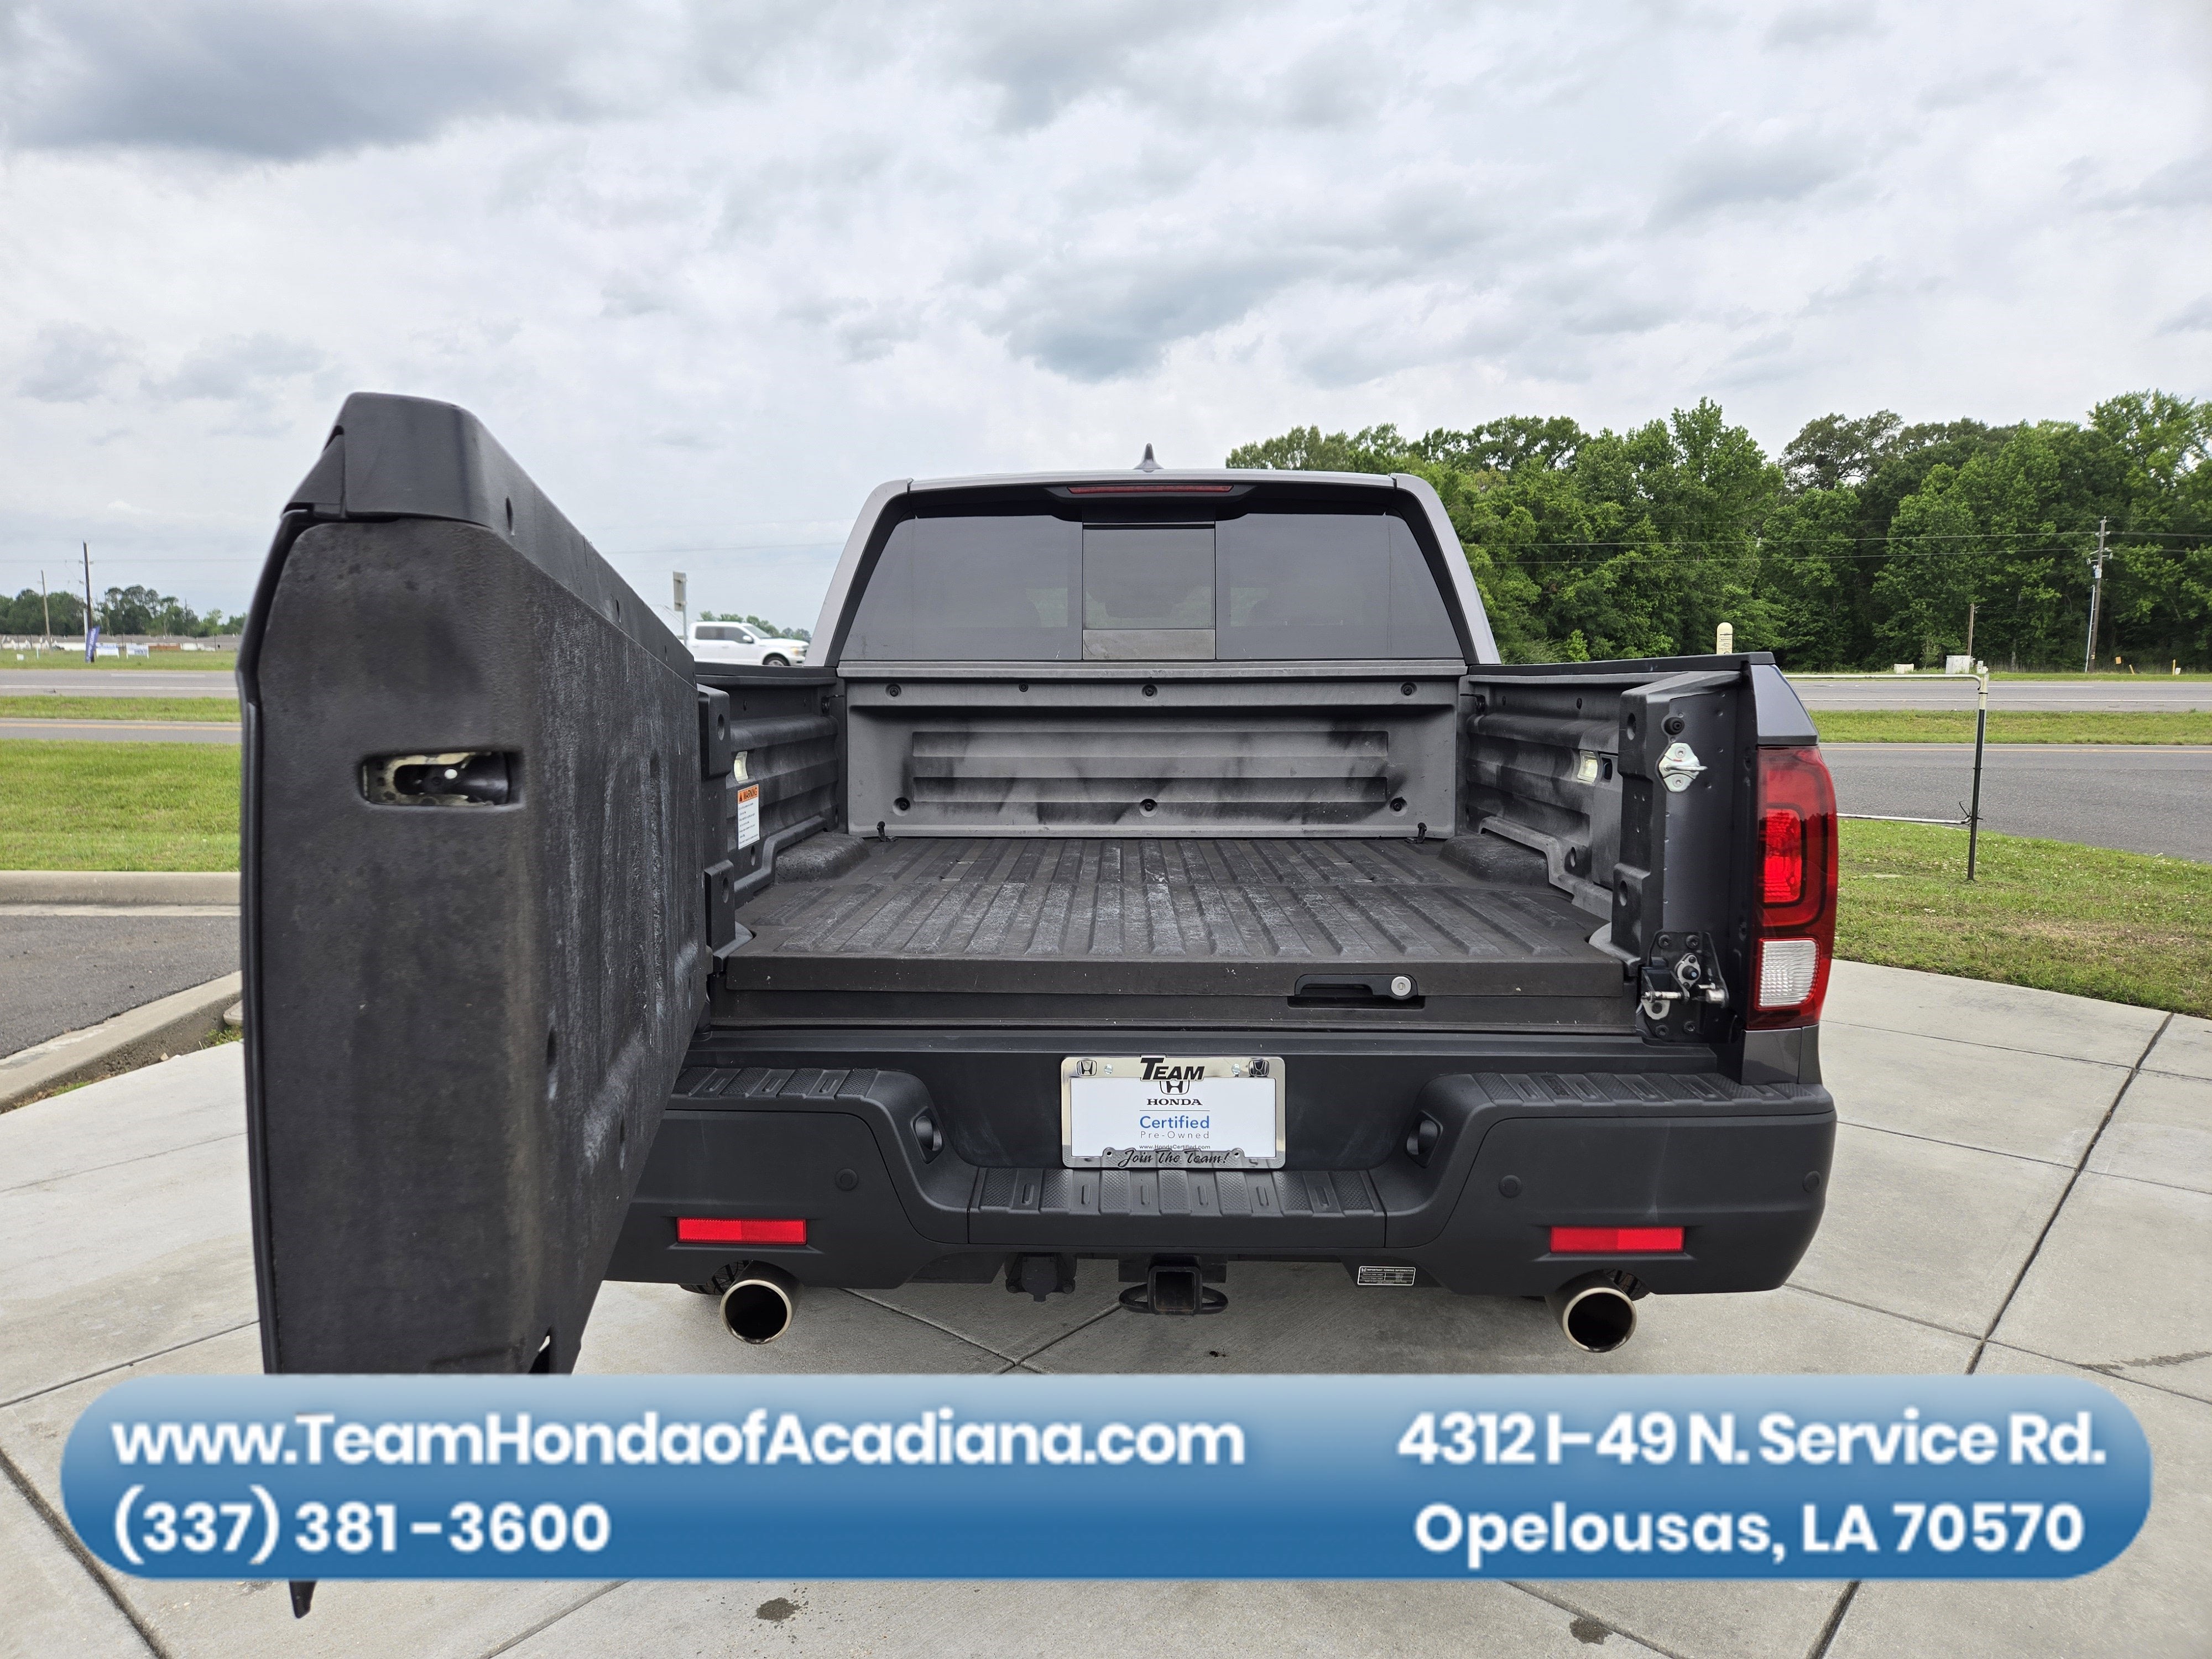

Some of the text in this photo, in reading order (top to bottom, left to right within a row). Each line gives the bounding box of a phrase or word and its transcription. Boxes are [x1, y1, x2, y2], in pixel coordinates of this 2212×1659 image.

[1140, 1115, 1210, 1129] Certified
[1140, 1130, 1209, 1139] Pre-Owned
[1118, 1150, 1231, 1168] Join The Team!
